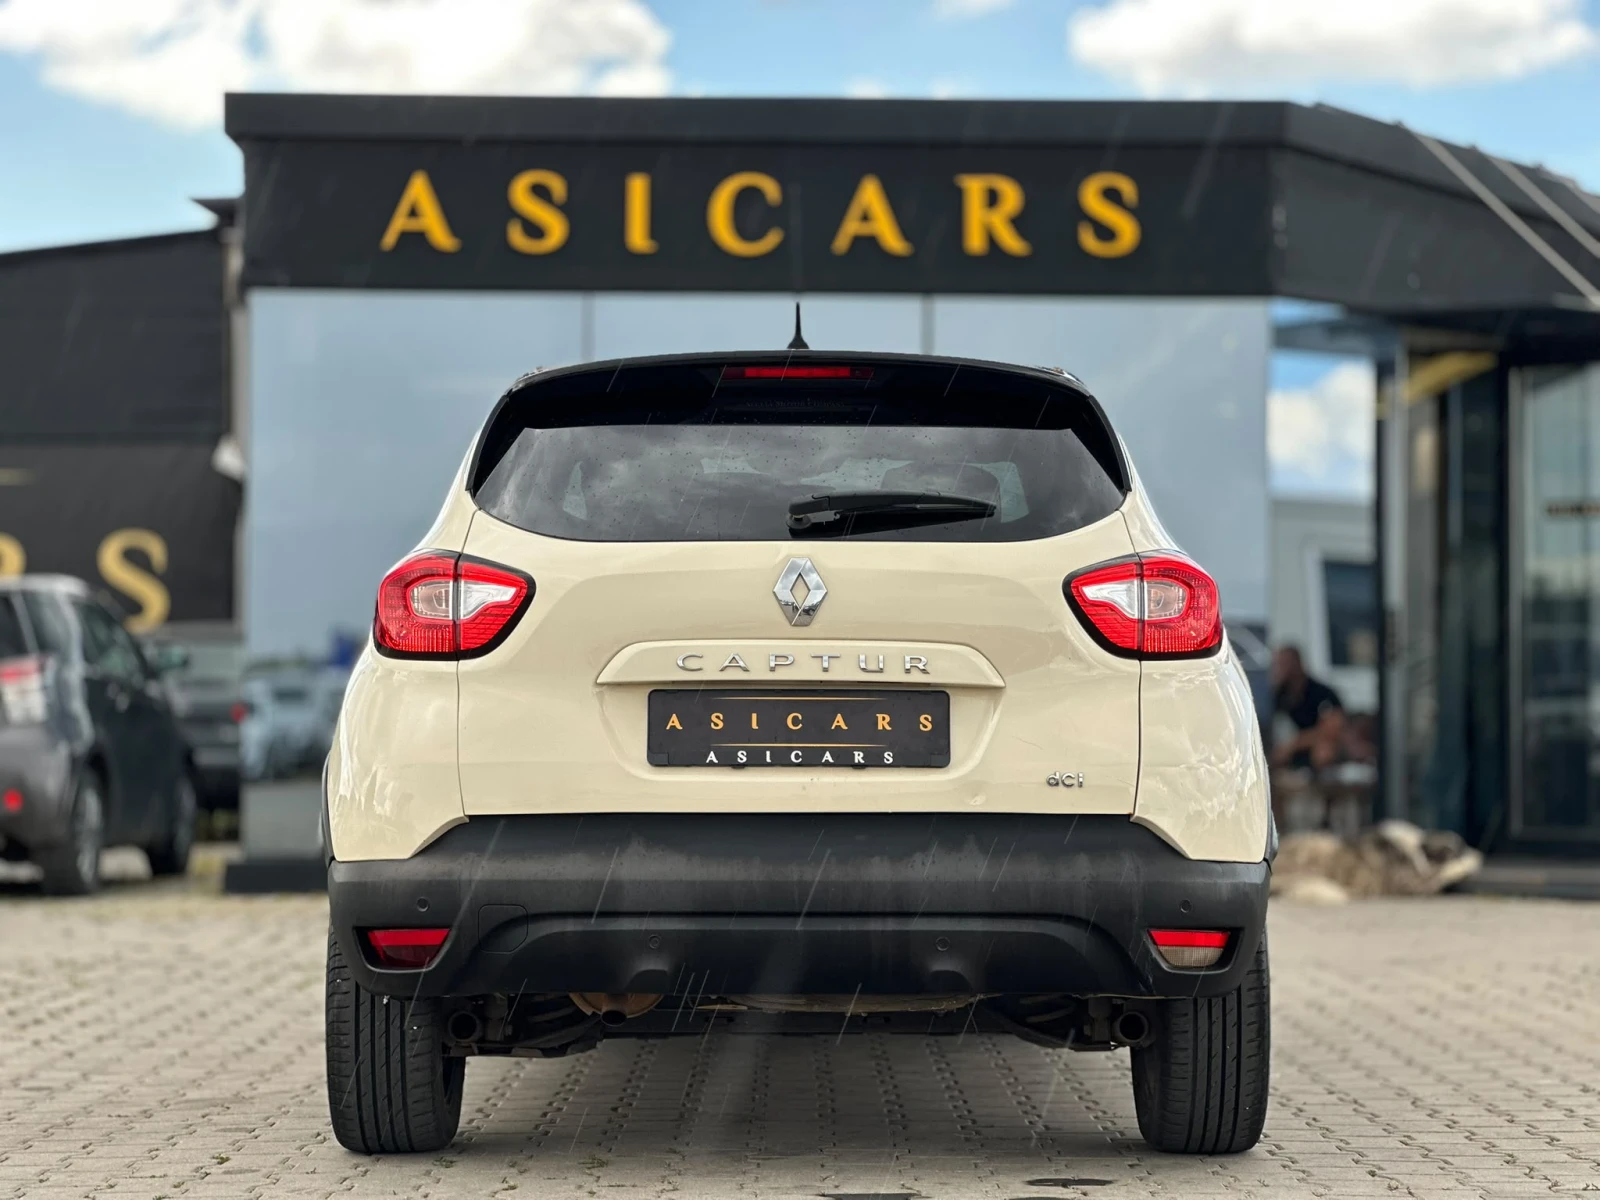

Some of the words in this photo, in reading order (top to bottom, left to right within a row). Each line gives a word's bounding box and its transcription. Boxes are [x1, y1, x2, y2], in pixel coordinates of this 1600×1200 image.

[381, 168, 1141, 258] ASICARS
[676, 652, 931, 675] CAPTUR
[666, 712, 933, 732] ASICARS
[705, 750, 894, 765] ASICARS
[1046, 771, 1083, 788] dCi
